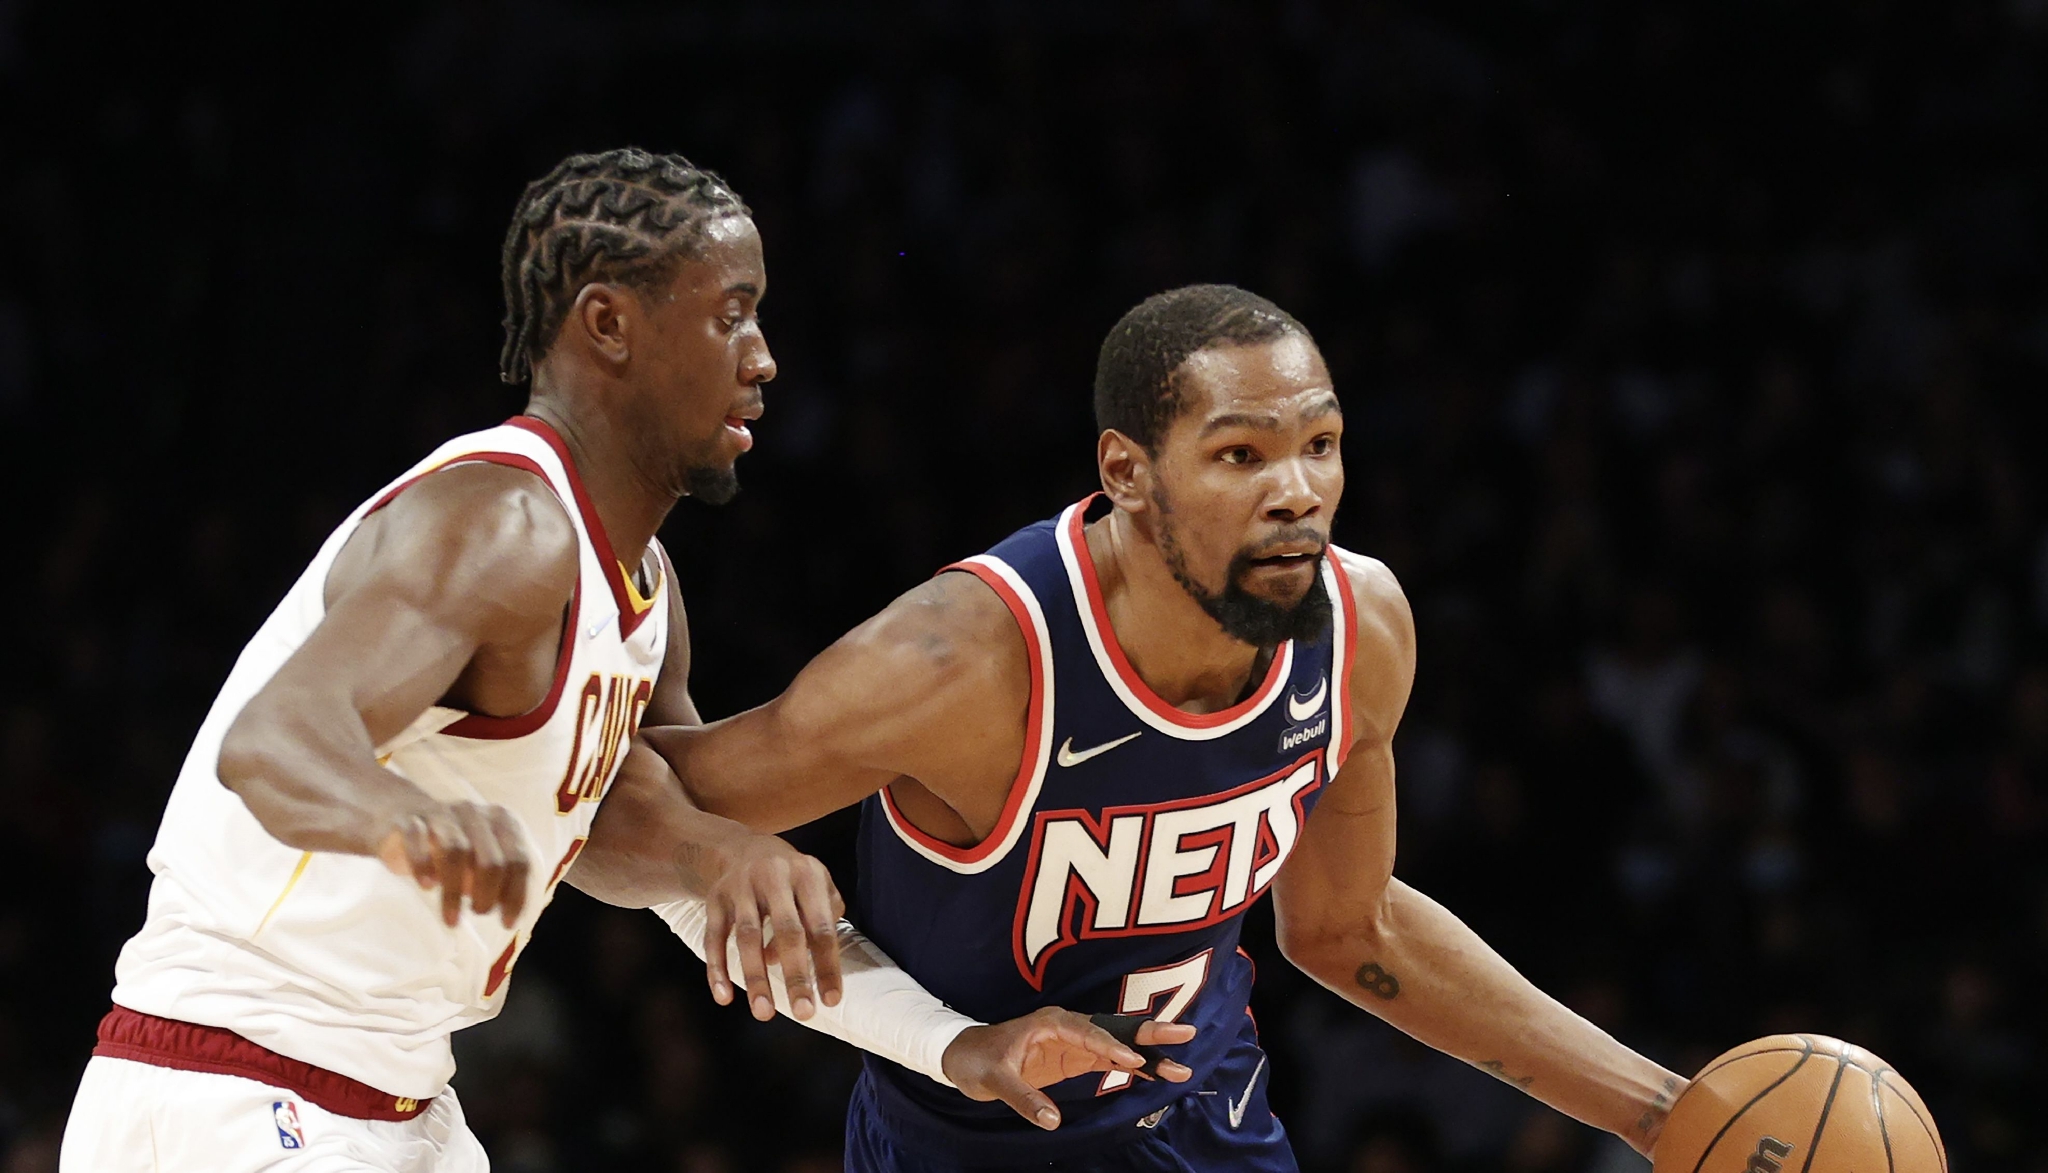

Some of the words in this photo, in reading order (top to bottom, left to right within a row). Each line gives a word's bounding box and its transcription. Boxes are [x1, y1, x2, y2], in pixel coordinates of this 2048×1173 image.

[1282, 719, 1326, 750] Webull
[1014, 750, 1323, 990] NETS
[1096, 948, 1213, 1096] 7
